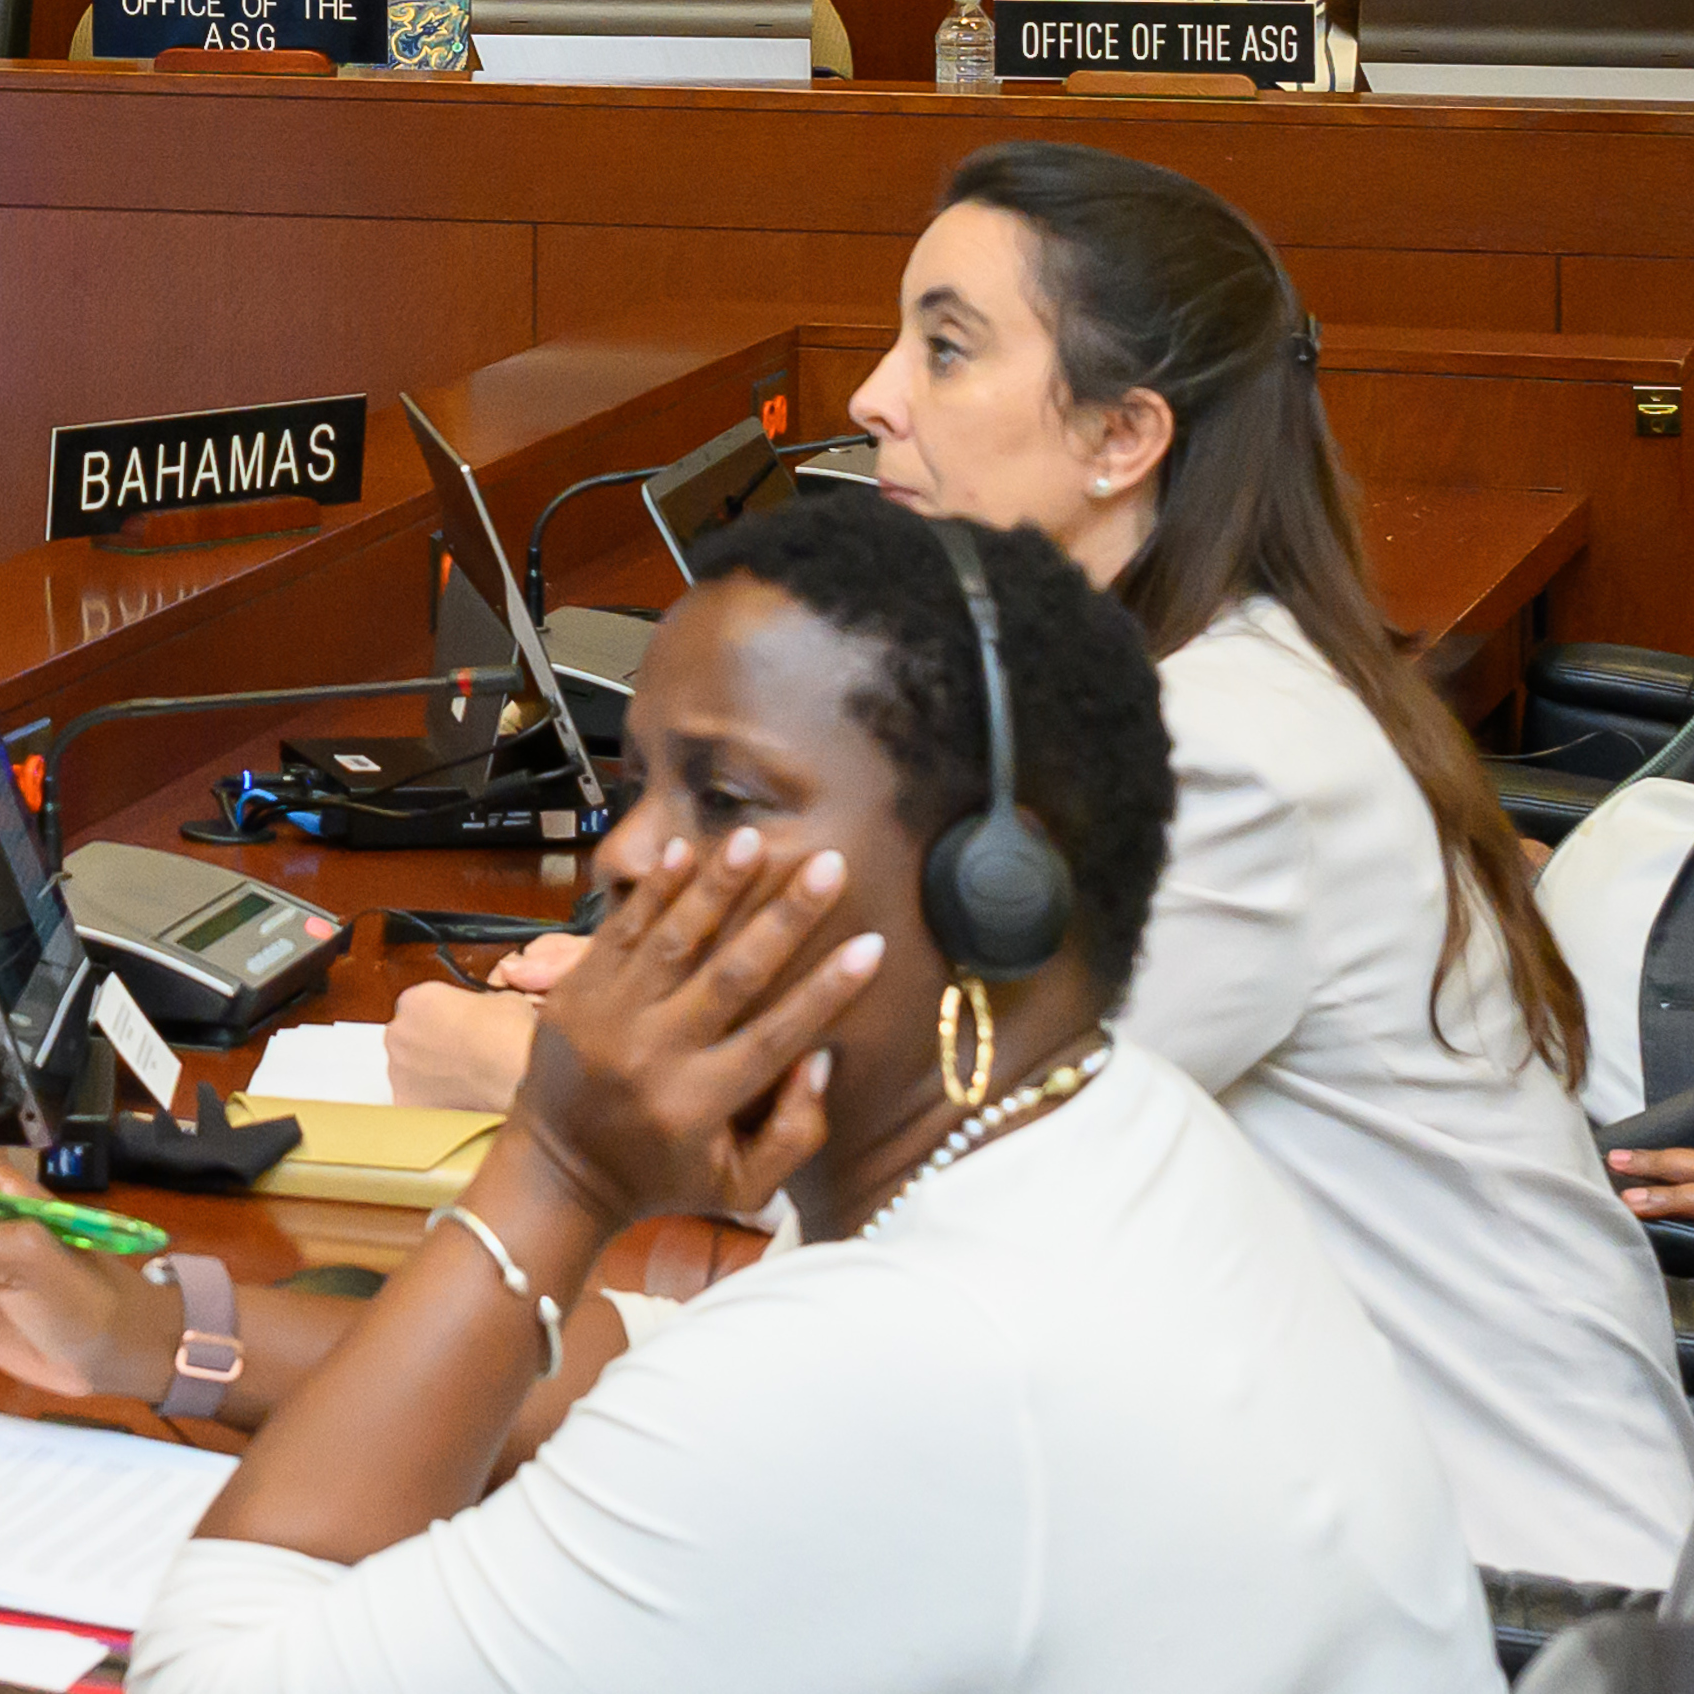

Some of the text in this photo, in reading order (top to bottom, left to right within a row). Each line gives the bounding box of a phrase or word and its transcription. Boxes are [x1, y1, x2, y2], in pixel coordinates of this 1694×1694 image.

[203, 22, 276, 51] ASG
[1021, 21, 1299, 64] OFFICE OF THE ASG
[80, 423, 337, 512] BAHAMAS
